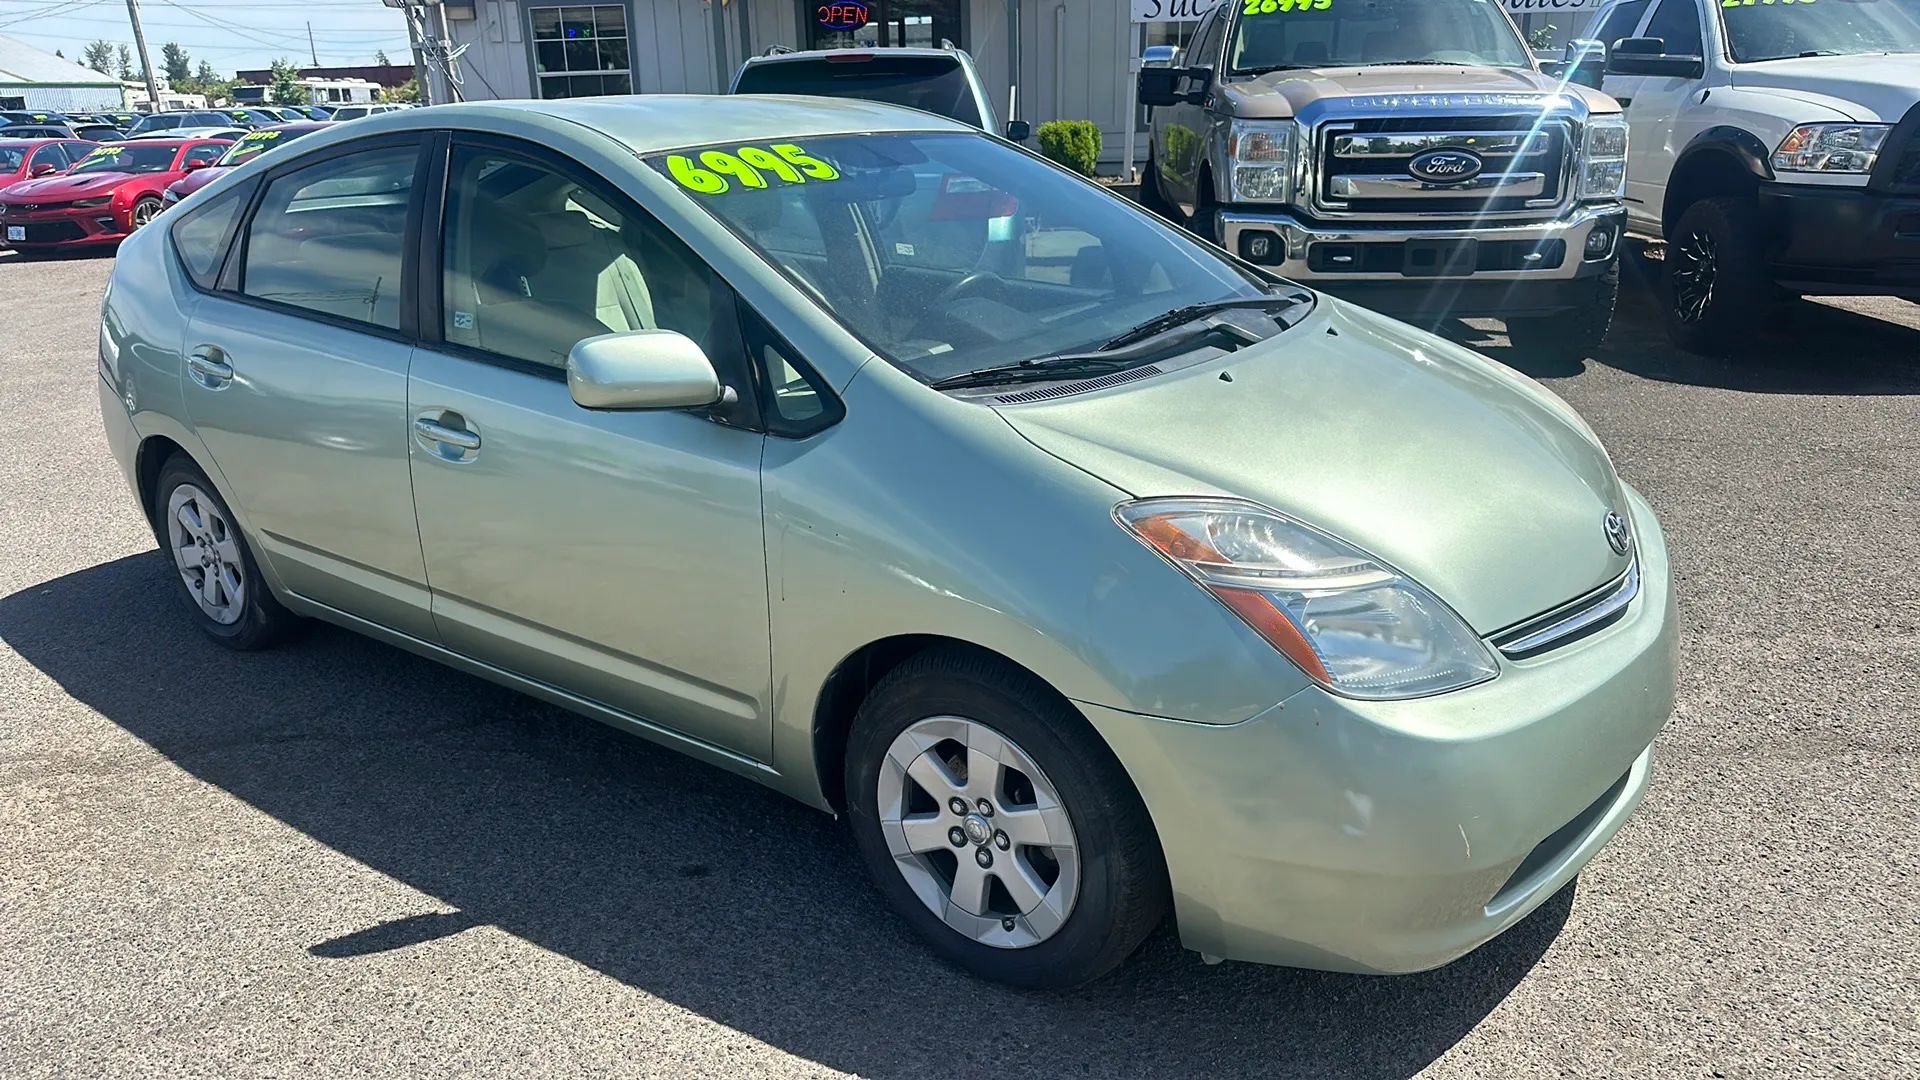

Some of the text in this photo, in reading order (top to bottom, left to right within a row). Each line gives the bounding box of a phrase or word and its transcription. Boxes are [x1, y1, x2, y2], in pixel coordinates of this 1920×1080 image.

[817, 5, 868, 24] OPEN
[1243, 0, 1332, 15] 26995
[666, 144, 840, 195] 6995
[1426, 156, 1467, 174] Ford
